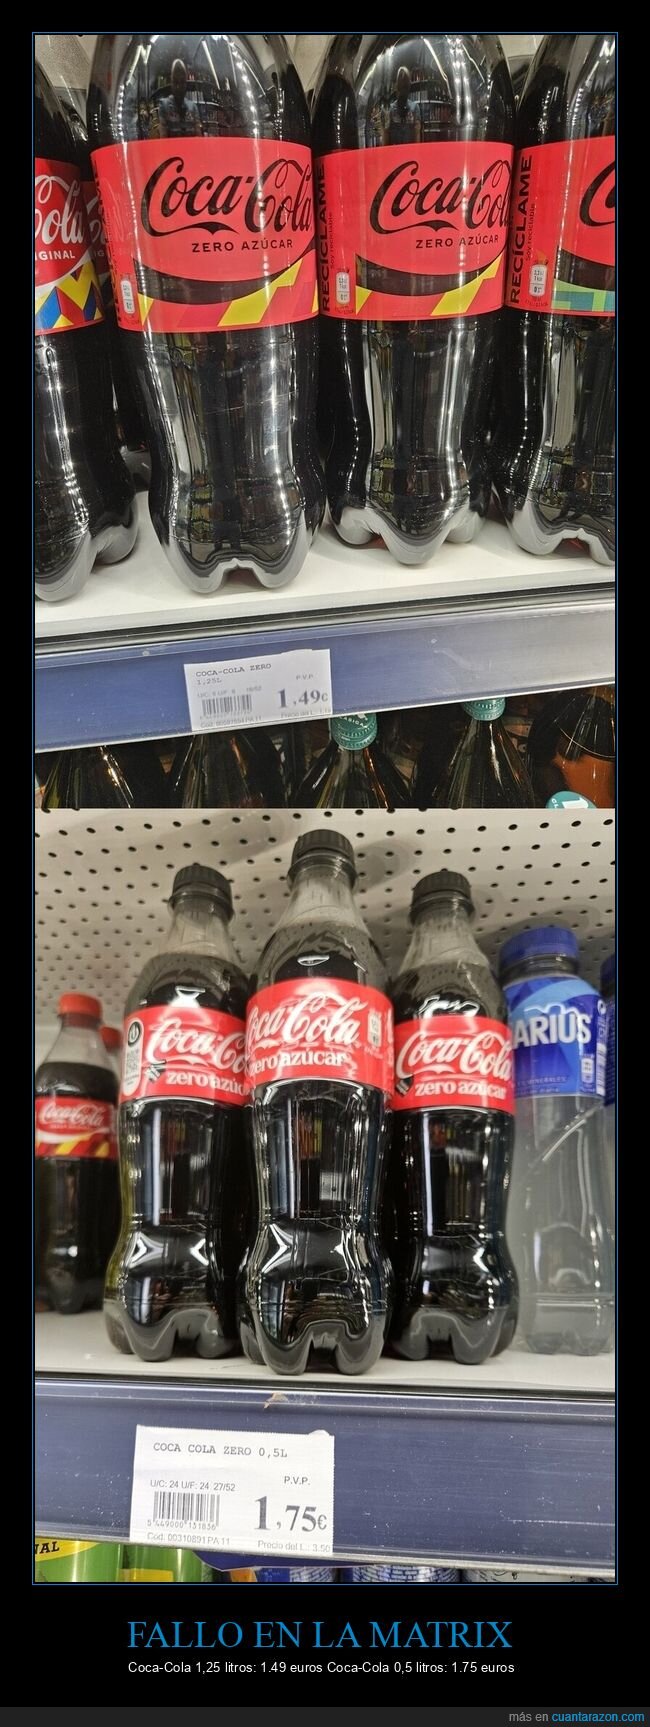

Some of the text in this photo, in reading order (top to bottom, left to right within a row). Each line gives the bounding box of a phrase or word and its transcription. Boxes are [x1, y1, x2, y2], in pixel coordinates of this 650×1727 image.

[141, 157, 313, 237] Coca-Cola
[510, 155, 532, 304] RECÍCLAME
[192, 238, 293, 253] ZERO AZÚCAR
[415, 233, 499, 249] ZERO AZÚCAR
[195, 663, 272, 677] COCA-COLA ZERO
[279, 1047, 346, 1067] azúcar
[396, 1030, 512, 1081] Coca-Cola
[165, 1071, 209, 1088] zero
[415, 1081, 457, 1097] zero
[153, 1442, 288, 1459] COCA COLA ZERO 0,5L
[150, 1479, 168, 1488] U/C:
[169, 1481, 179, 1489] 24
[199, 1482, 210, 1491] 24
[213, 1482, 236, 1492] 27/52
[284, 1475, 311, 1486] P.V.P.
[253, 1495, 328, 1533] 1,75€
